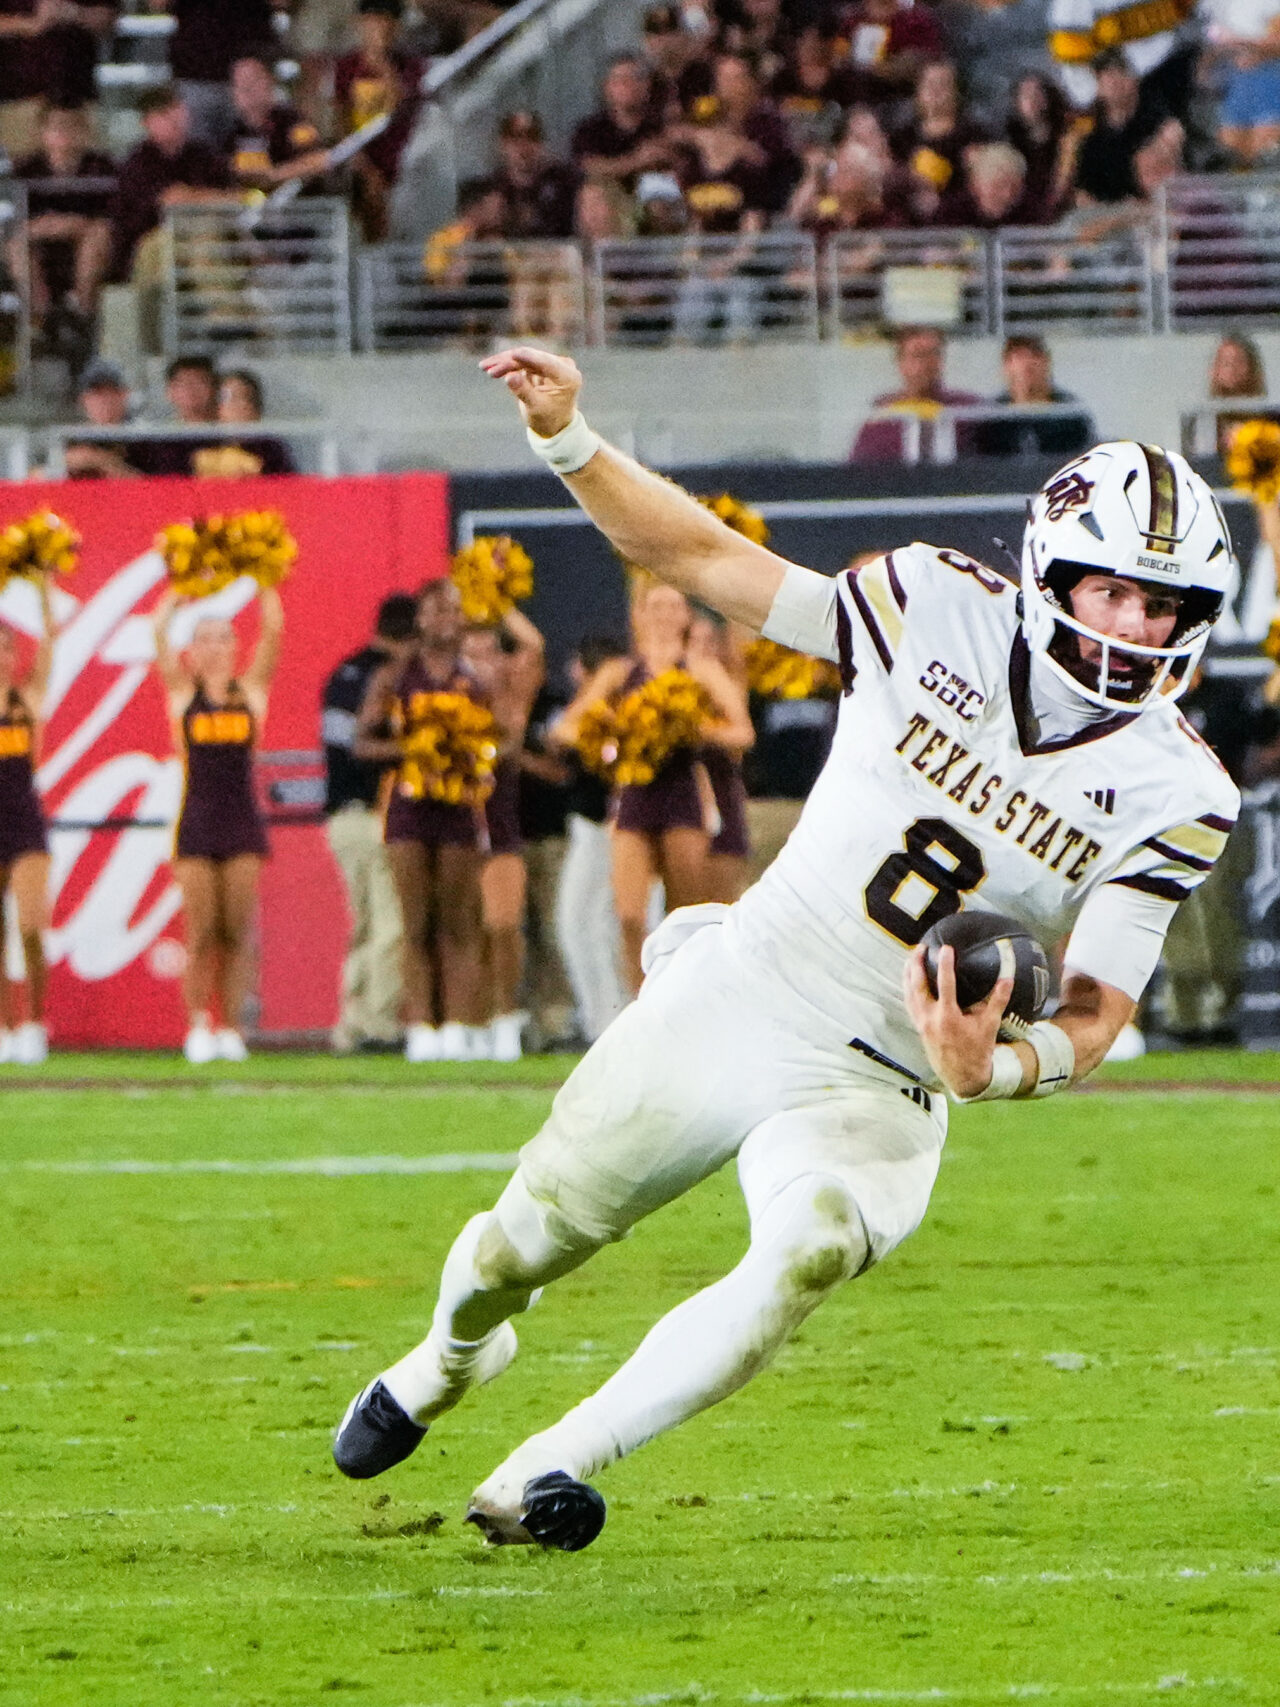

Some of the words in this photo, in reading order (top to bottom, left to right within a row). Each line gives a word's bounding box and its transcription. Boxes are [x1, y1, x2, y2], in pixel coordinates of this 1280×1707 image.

[1136, 555, 1181, 574] BOBCATS
[919, 660, 985, 721] SBC
[894, 711, 1003, 816] TEXAS
[994, 789, 1104, 884] STATE
[862, 815, 989, 950] 8
